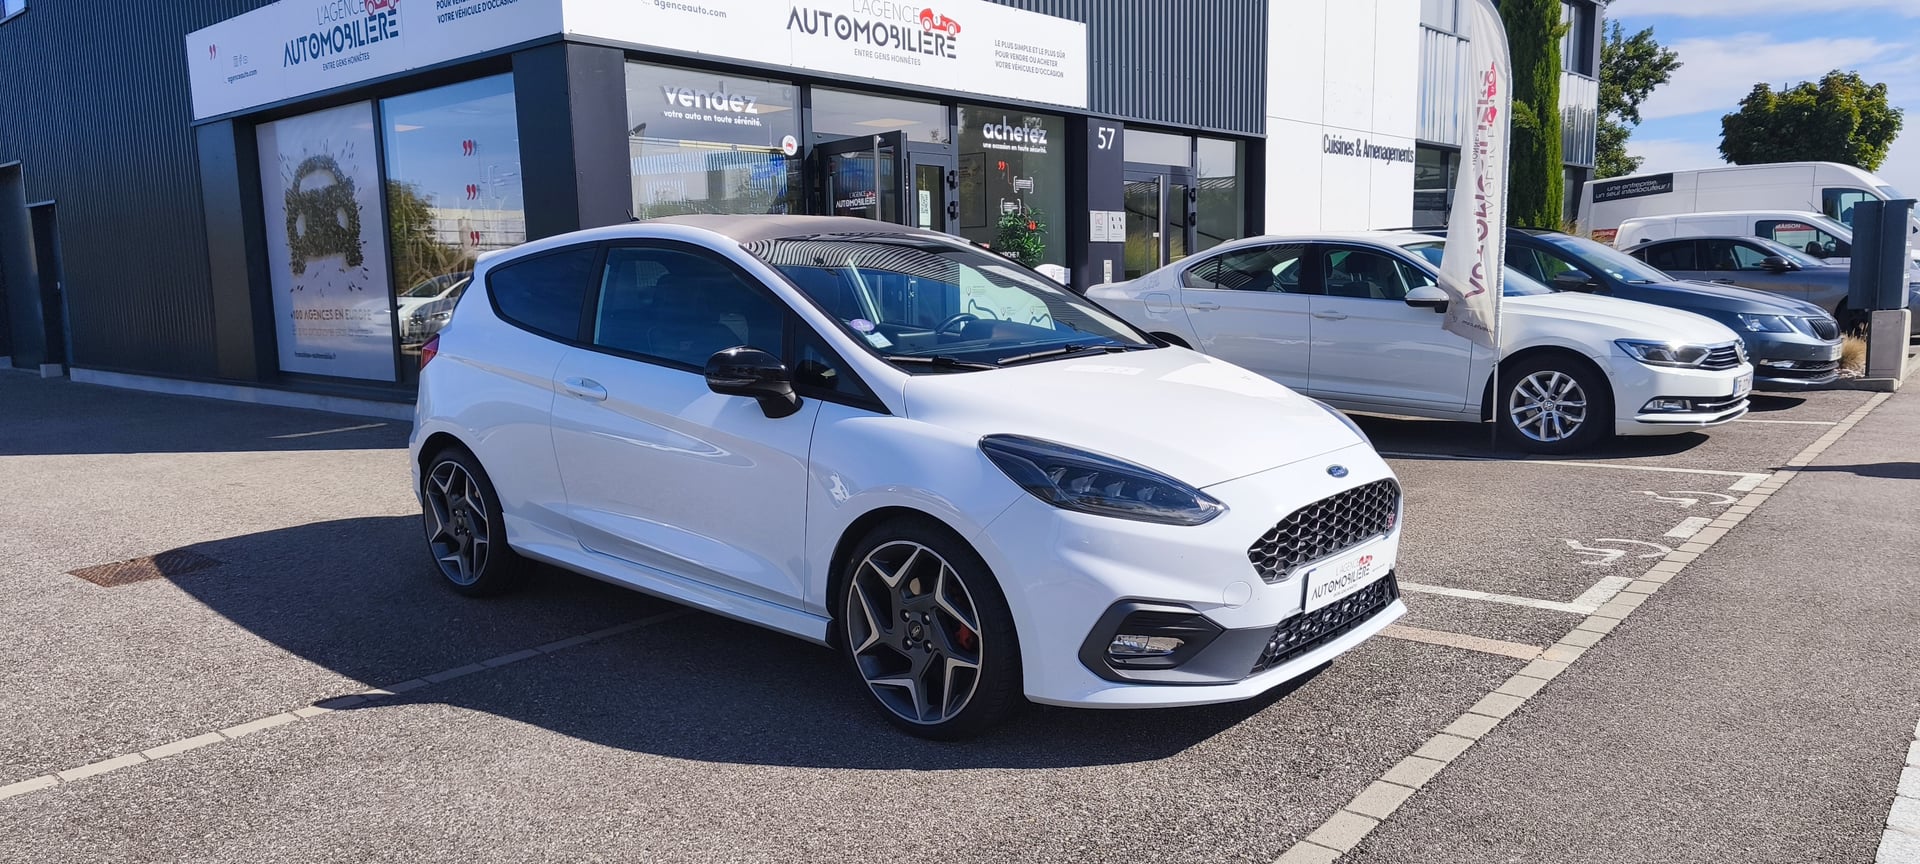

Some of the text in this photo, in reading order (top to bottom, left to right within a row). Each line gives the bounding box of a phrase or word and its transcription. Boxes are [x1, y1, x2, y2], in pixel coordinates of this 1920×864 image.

[437, 12, 455, 24] VOTRE
[455, 3, 481, 19] VÉHICULE
[482, 0, 517, 11] D'OCCASI
[854, 48, 921, 66] ENTRE GENS HONNÊTES
[994, 39, 1001, 47] LE
[1001, 41, 1014, 50] PLUS
[1014, 43, 1032, 53] SIMPLE
[1032, 46, 1038, 54] ET
[1044, 49, 1056, 58] PLUS
[322, 60, 336, 71] ENTRE
[336, 58, 347, 68] GENS
[995, 50, 1058, 67] POUR VENDRE OU ACHETER
[995, 60, 1011, 70] VOTRE
[663, 80, 758, 114] vendez
[663, 110, 682, 118] votre
[684, 112, 701, 120] auto
[714, 115, 732, 124] toute
[983, 115, 1048, 144] achetez
[1097, 127, 1116, 150] 57
[1323, 133, 1415, 165] Cuisines & Amenagements
[304, 309, 333, 320] AGENCES
[335, 309, 344, 320] EN
